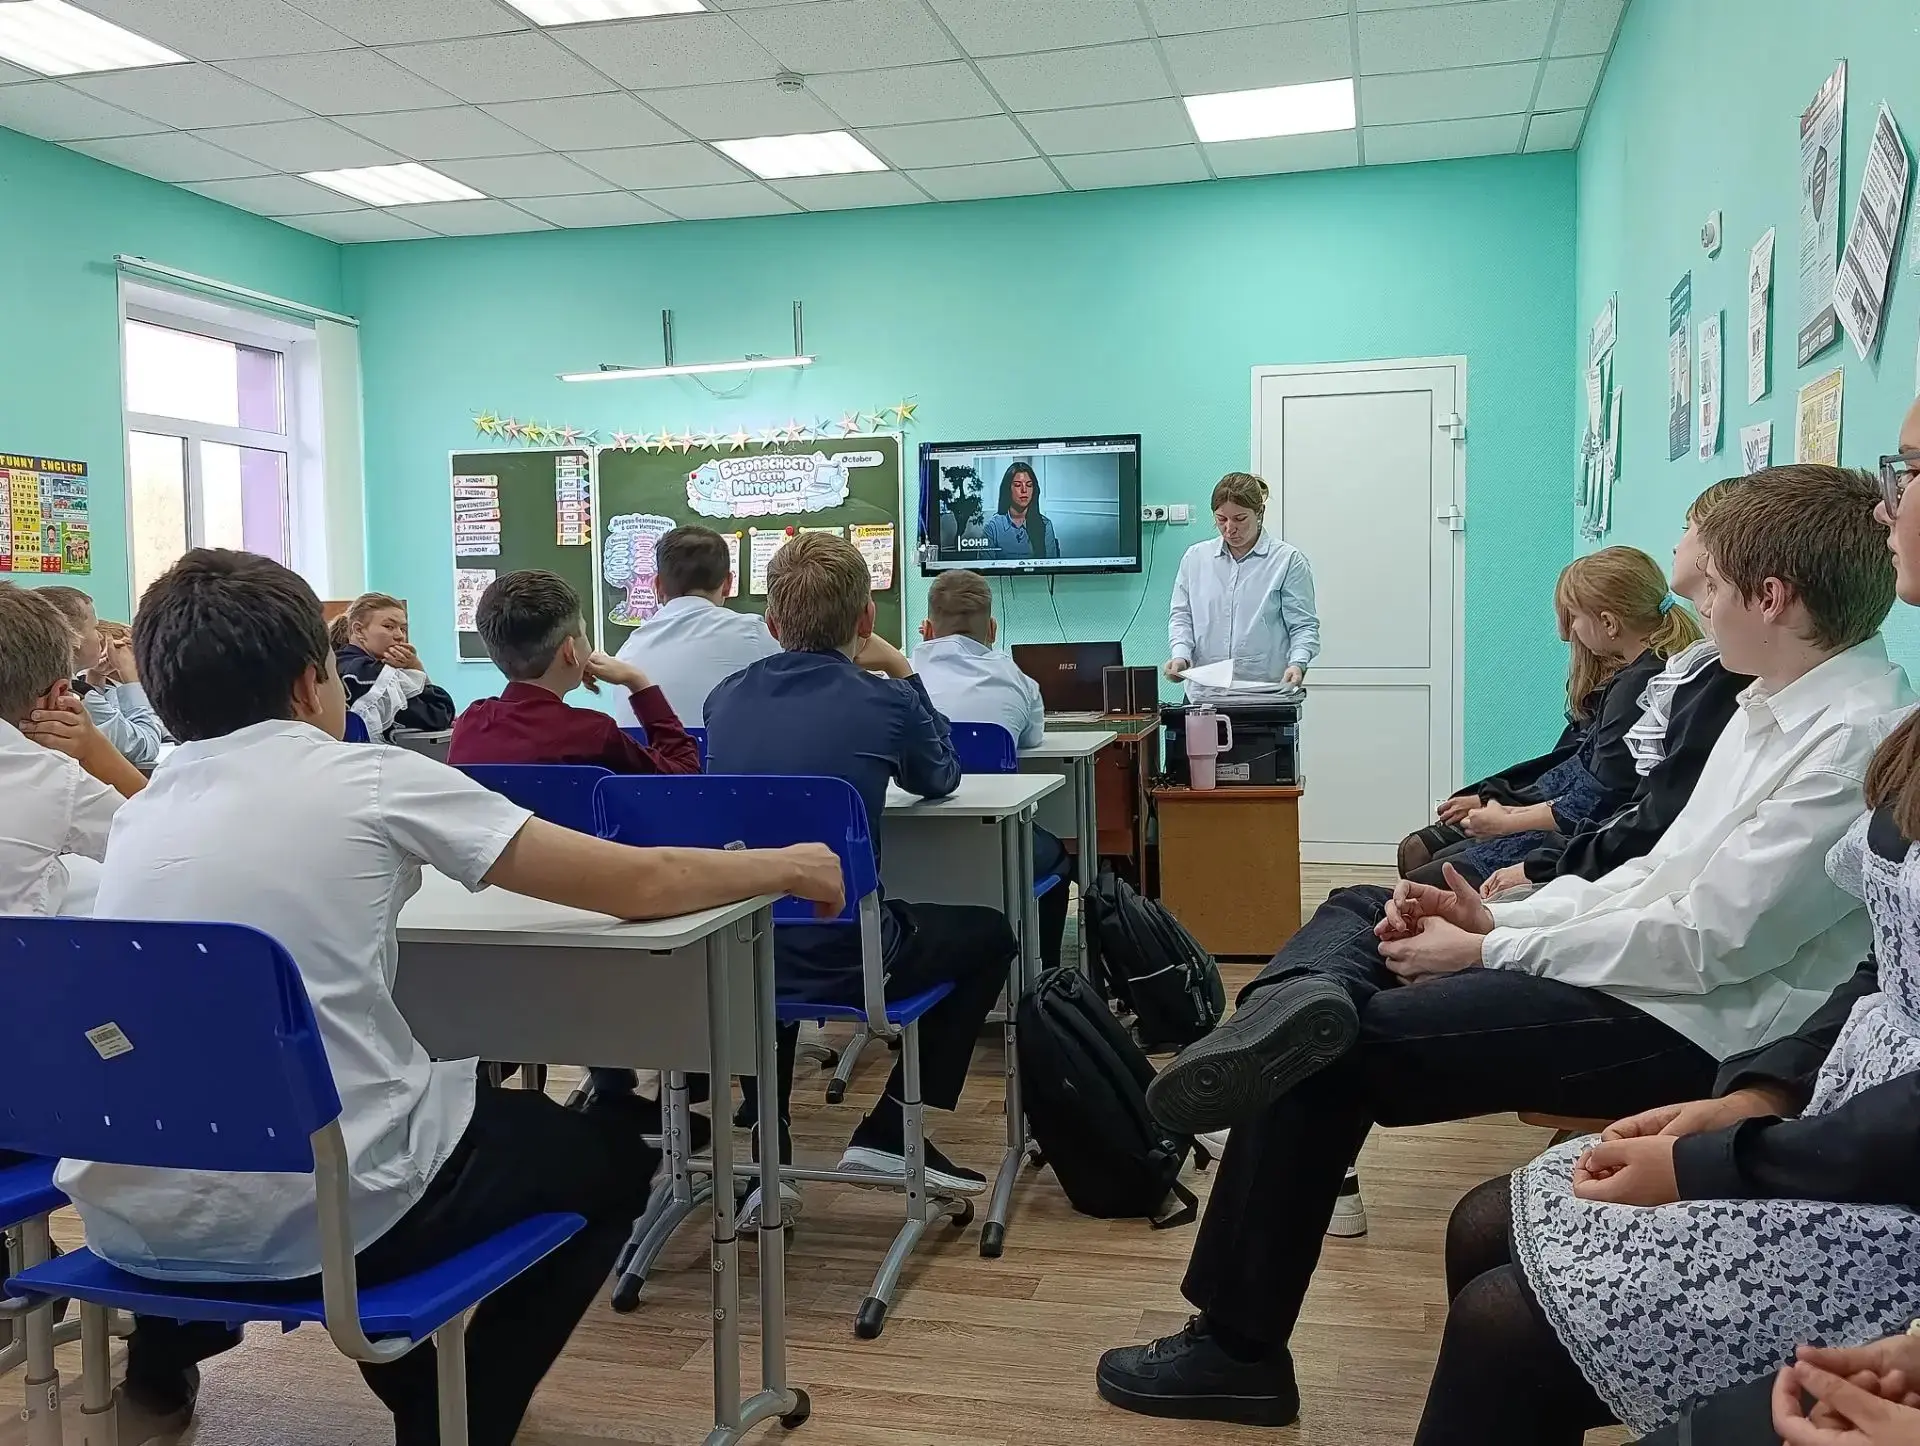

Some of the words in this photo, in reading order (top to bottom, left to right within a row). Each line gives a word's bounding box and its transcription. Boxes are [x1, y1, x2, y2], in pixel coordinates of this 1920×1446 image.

[0, 455, 34, 469] FUNNY
[41, 460, 84, 474] ENGLISH
[841, 455, 872, 463] October
[718, 457, 814, 479] Безопасность
[749, 472, 758, 482] в
[760, 470, 785, 481] сети
[731, 478, 803, 497] Интернет
[462, 501, 492, 509] WEDNESDAY
[464, 511, 490, 520] THURSDAY
[613, 519, 635, 527] Дерево
[635, 516, 673, 527] безопасности
[961, 538, 989, 547] СОНЯ
